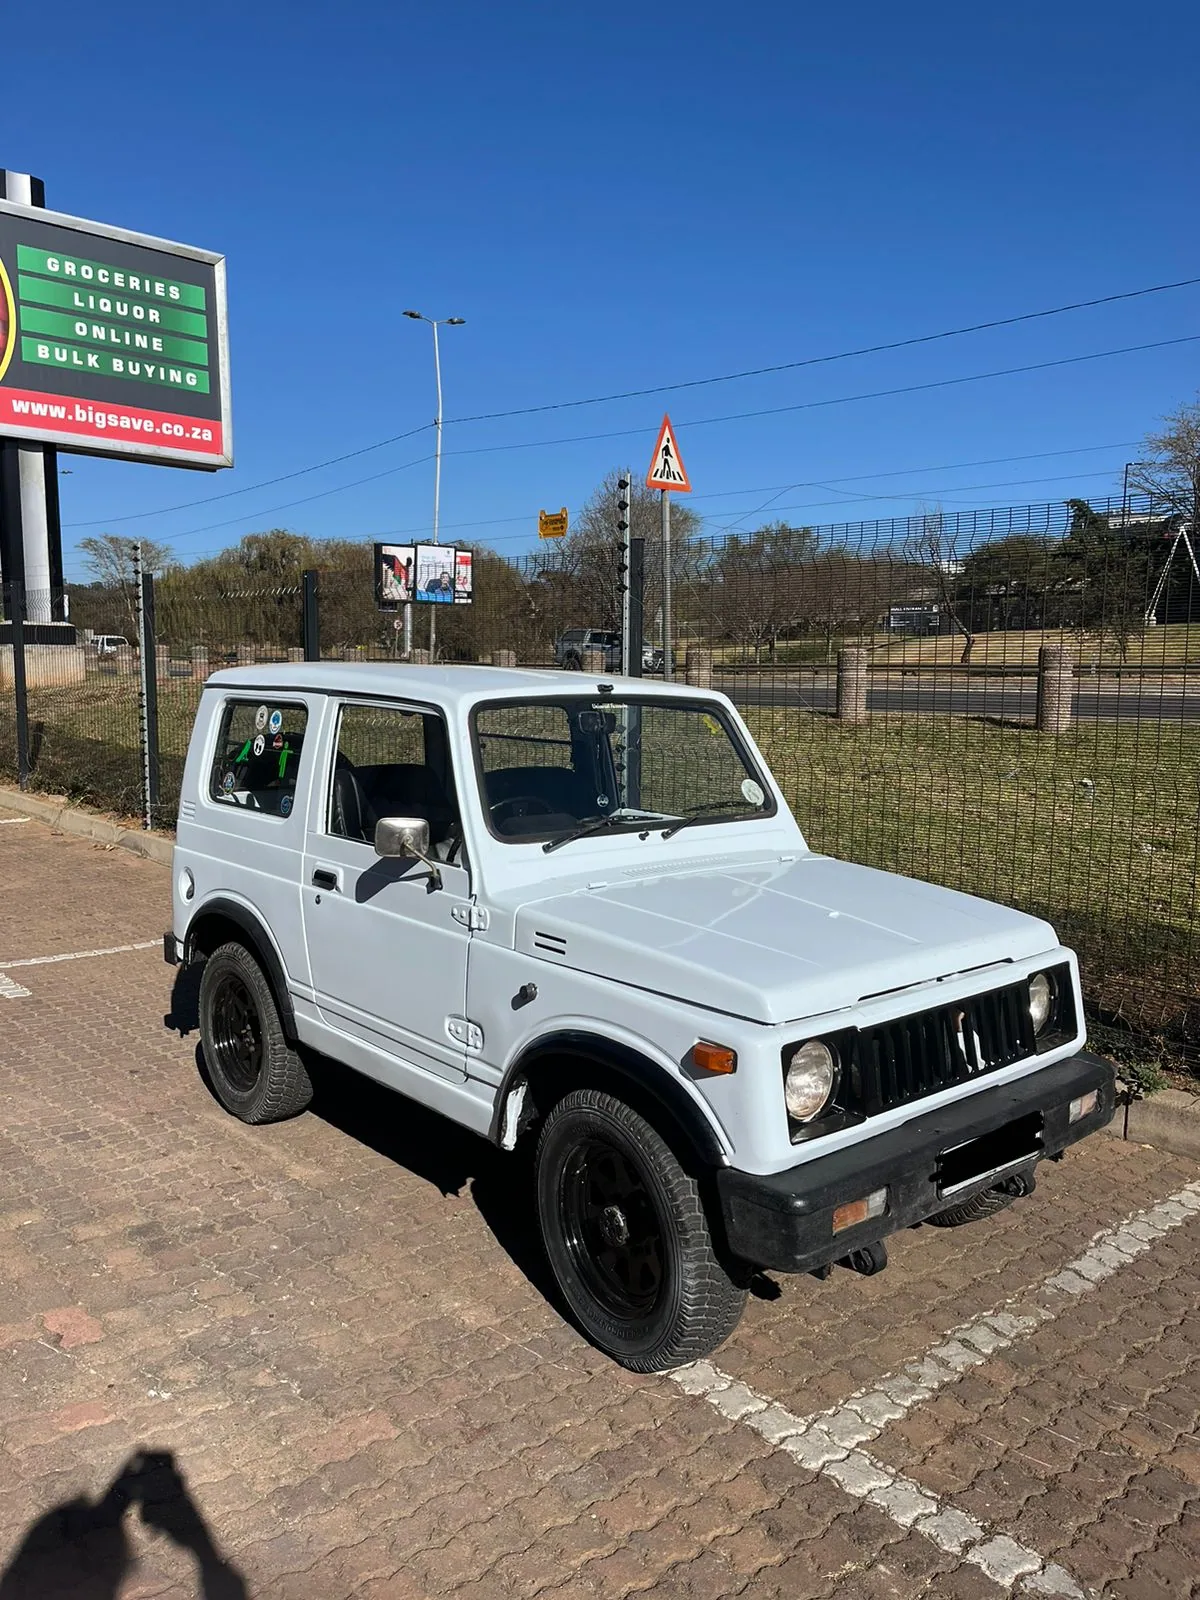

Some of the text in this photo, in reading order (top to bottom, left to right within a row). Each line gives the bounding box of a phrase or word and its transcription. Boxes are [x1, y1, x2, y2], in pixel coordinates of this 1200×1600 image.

[46, 257, 181, 300] GROCERIES
[73, 292, 161, 324] LIQUOR
[74, 321, 164, 352] ONLINE
[37, 344, 198, 387] BULK BUYING
[11, 399, 213, 442] www.bigsave.co.za
